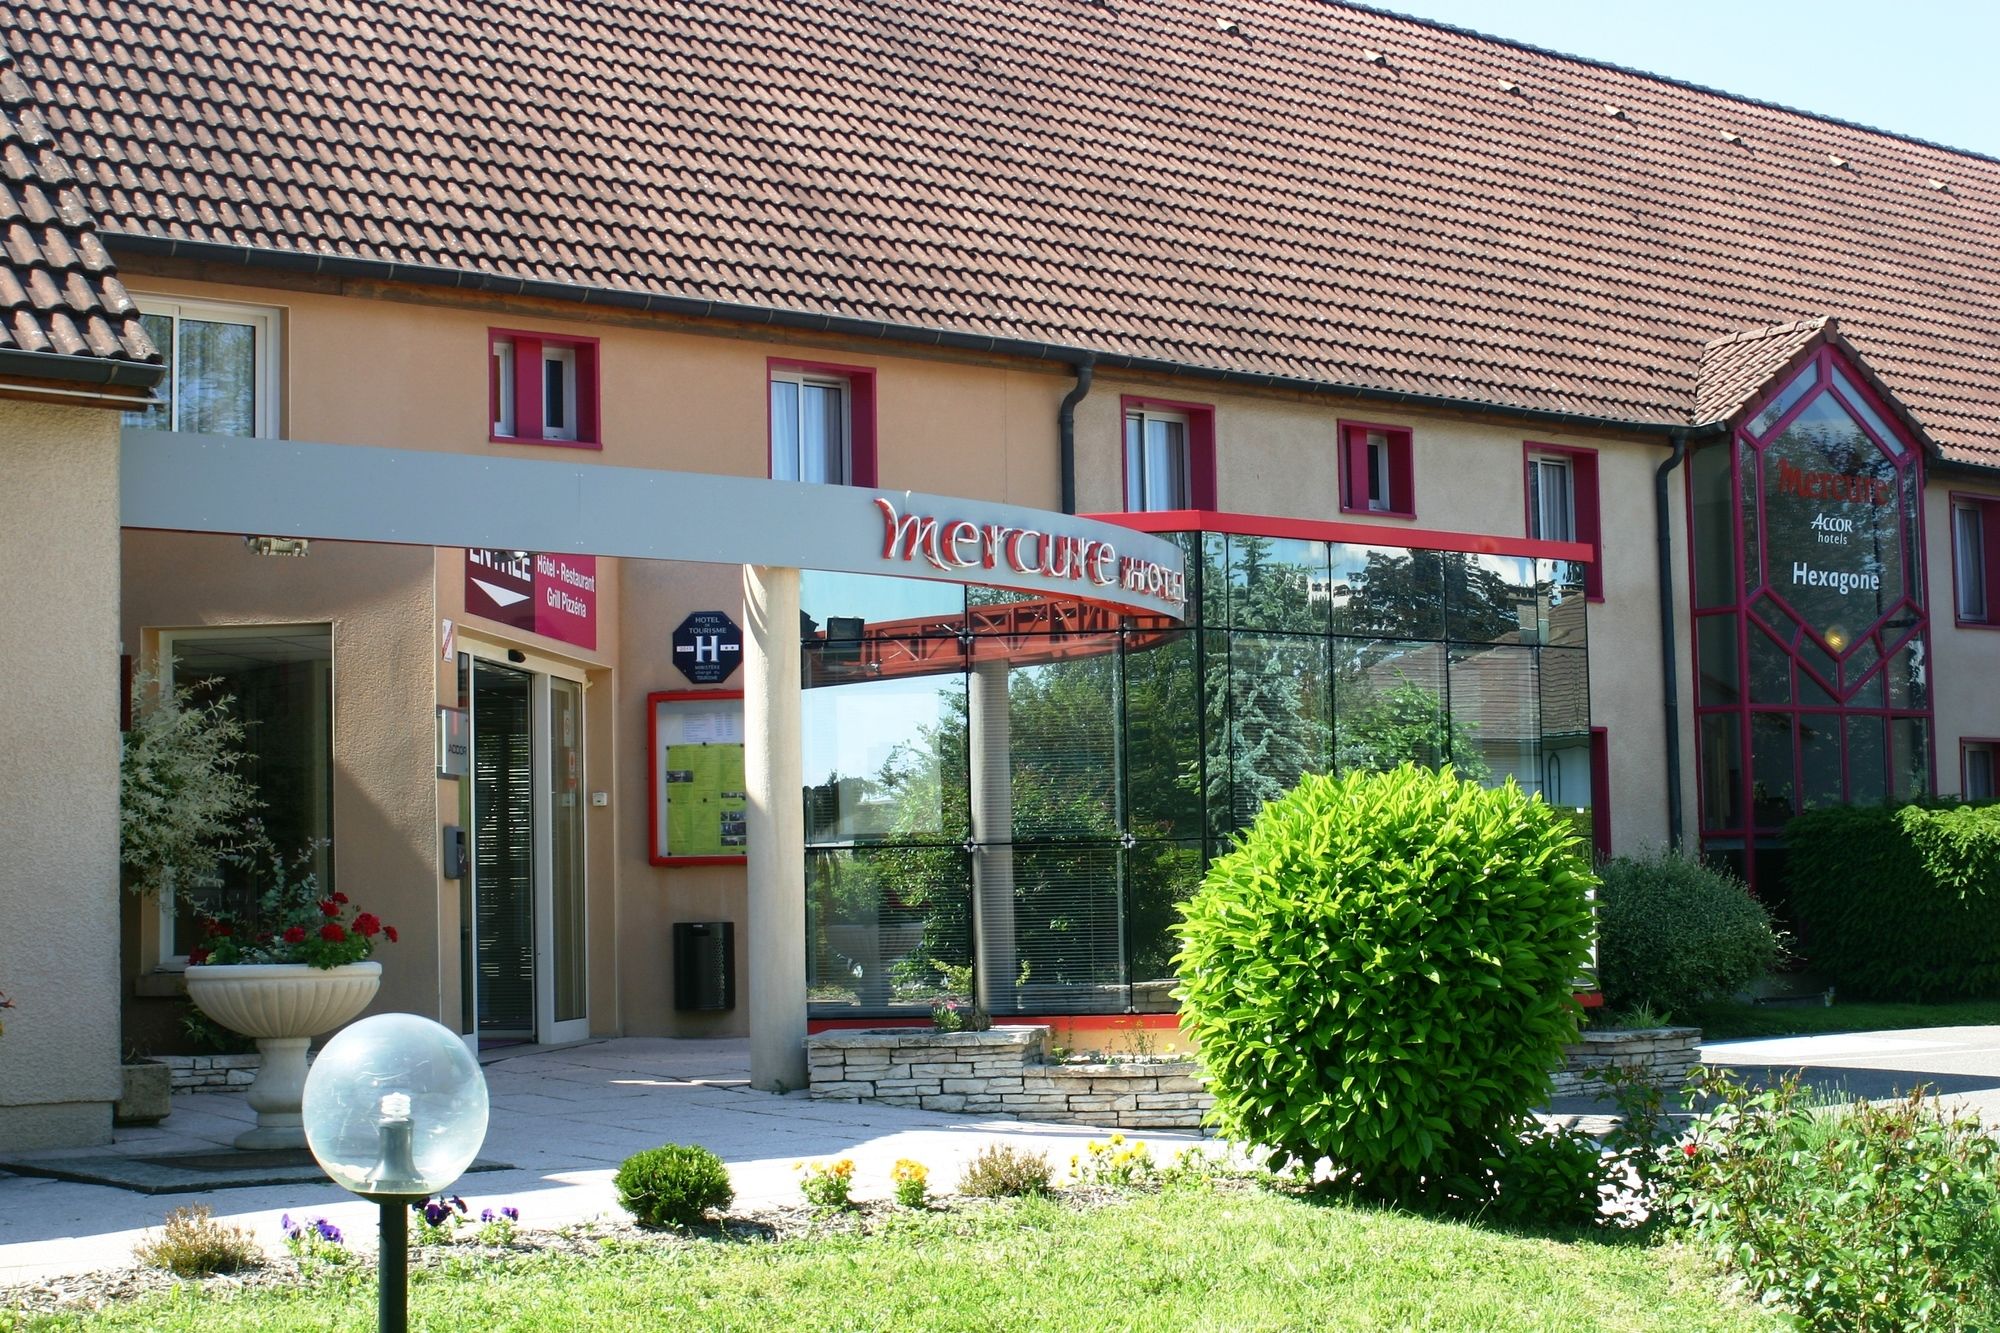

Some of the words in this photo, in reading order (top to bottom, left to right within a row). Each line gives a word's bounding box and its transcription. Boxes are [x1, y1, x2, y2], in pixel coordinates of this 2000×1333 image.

[1776, 457, 1888, 506] Mercure
[1811, 513, 1852, 532] ACCOR
[1817, 532, 1848, 545] hotels
[537, 554, 555, 578] Hôtel
[560, 561, 595, 592] Restaurant
[1793, 562, 1880, 595] Hexagone
[546, 587, 560, 609] Grill
[561, 591, 587, 617] Pizzéria
[695, 635, 720, 663] H
